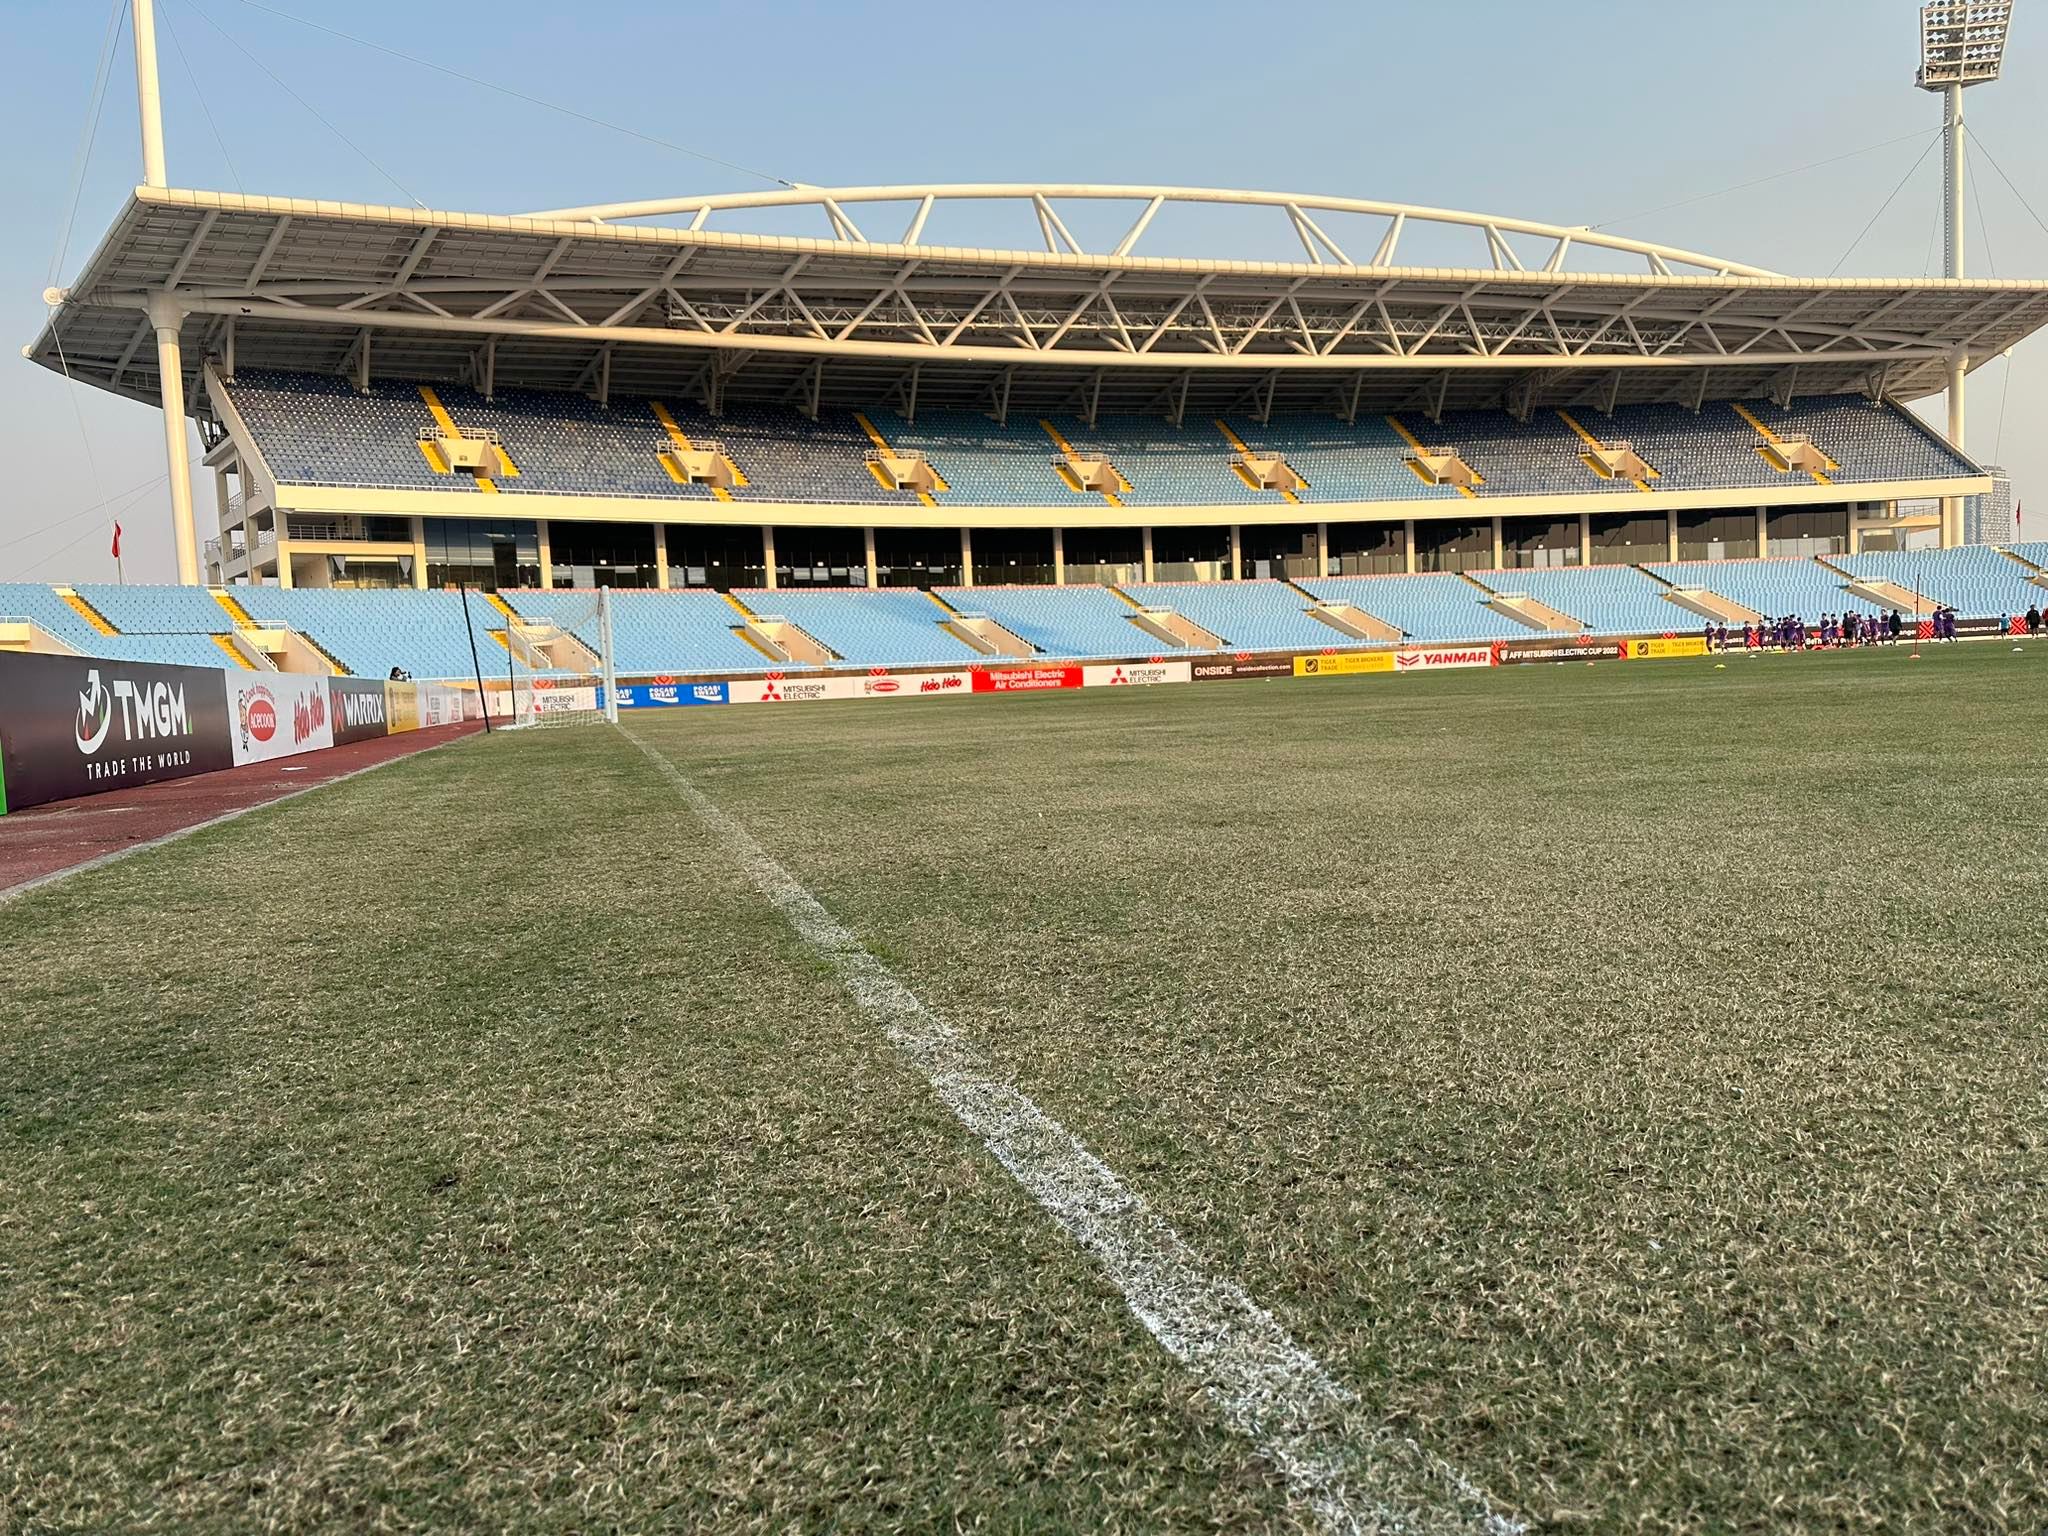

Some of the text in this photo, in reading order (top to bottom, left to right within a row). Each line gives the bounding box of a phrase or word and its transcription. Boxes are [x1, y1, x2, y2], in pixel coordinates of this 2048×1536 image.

[1424, 652, 1487, 664] YANMAR
[1509, 651, 1523, 659] AFF
[1523, 649, 1557, 658] MITSUBISHI
[1558, 648, 1588, 656] ELECTRIC
[1602, 646, 1618, 654] 2022
[990, 669, 1065, 681] Mitsubishi Electric
[1194, 666, 1233, 676] ONSIDE
[783, 684, 825, 692] MITSUBISHI
[994, 679, 1062, 689] Air Conditioners
[542, 695, 575, 703] MITSUBISHI
[783, 692, 820, 700] ELECTRIC
[113, 680, 188, 741] TMGM
[343, 693, 385, 727] WARRIX
[543, 703, 571, 711] ELECTRIC
[250, 712, 275, 730] ACECOOK
[87, 750, 191, 780] TRADE THE WORLD
